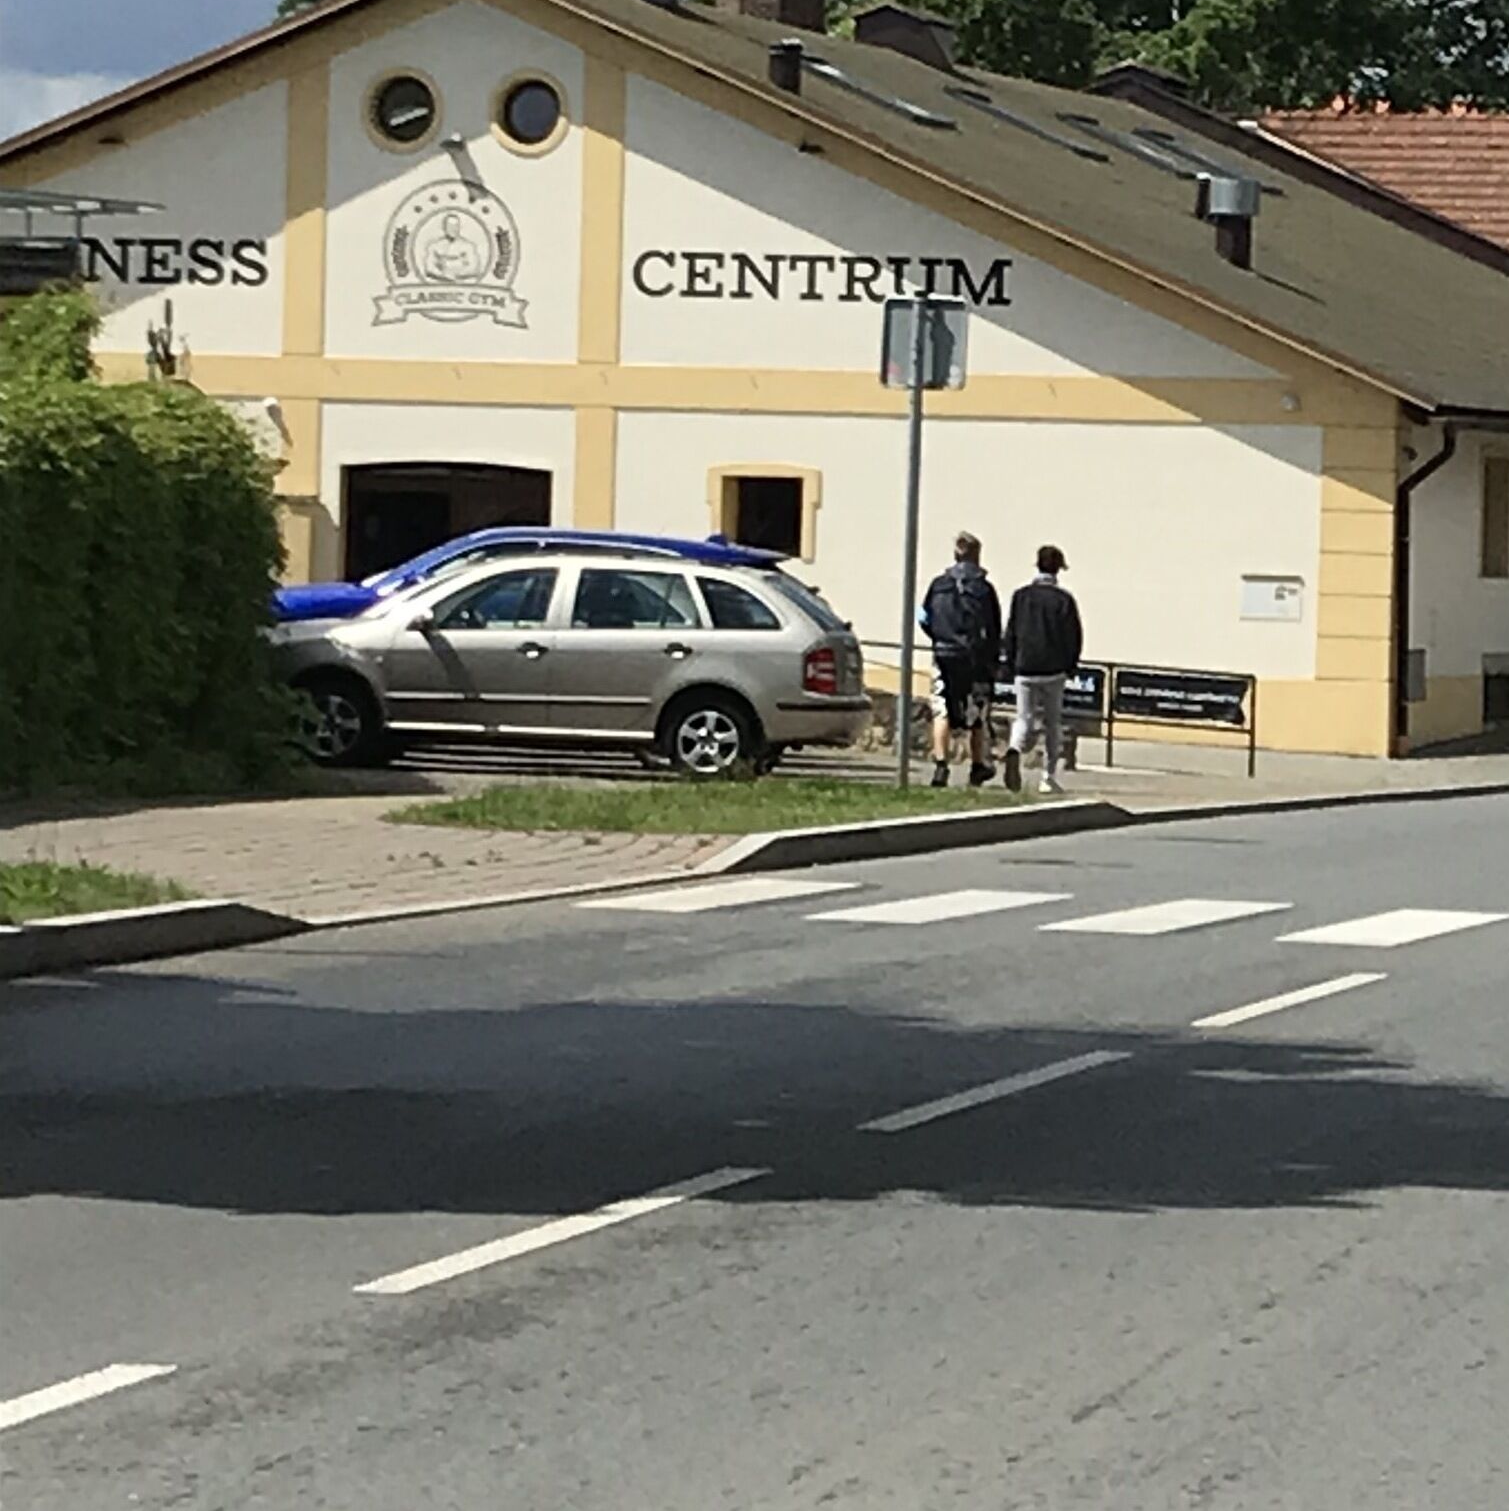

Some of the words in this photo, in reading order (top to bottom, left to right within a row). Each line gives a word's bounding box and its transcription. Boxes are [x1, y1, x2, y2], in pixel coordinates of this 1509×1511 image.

[633, 250, 1012, 305] CENTRUM
[394, 291, 464, 306] CLASSIC
[468, 292, 505, 308] GYM
